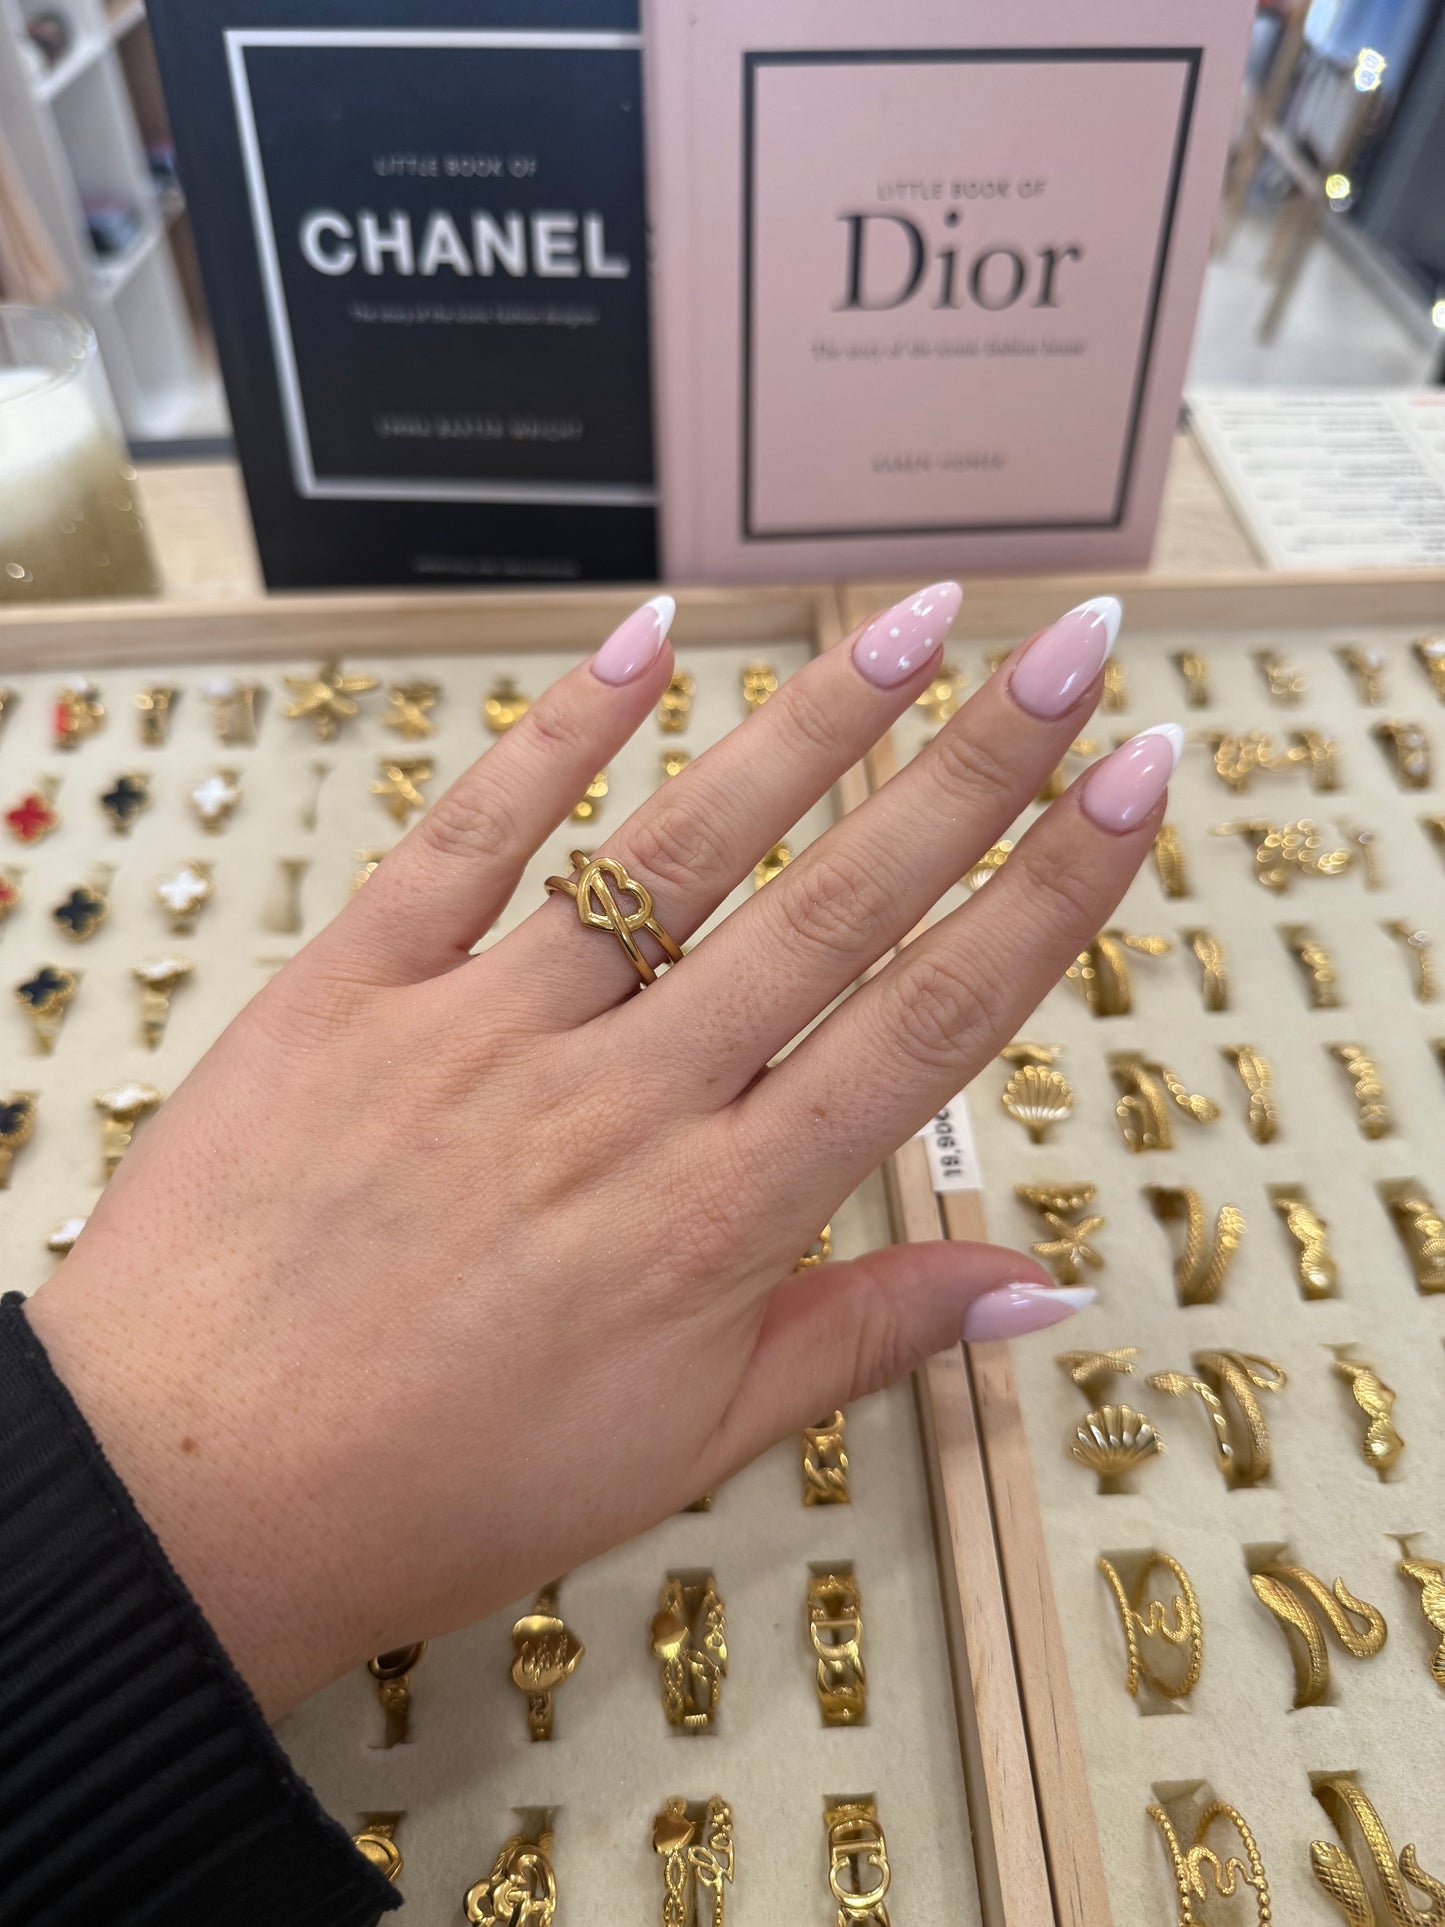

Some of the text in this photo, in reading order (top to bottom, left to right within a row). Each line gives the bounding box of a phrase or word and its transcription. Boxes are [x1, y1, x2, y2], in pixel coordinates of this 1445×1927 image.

[372, 154, 537, 178] LITTLE BOOK OF
[876, 176, 1047, 201] LITTLE BOOK OF
[301, 210, 629, 277] CHANEL
[834, 208, 1082, 311] Dior
